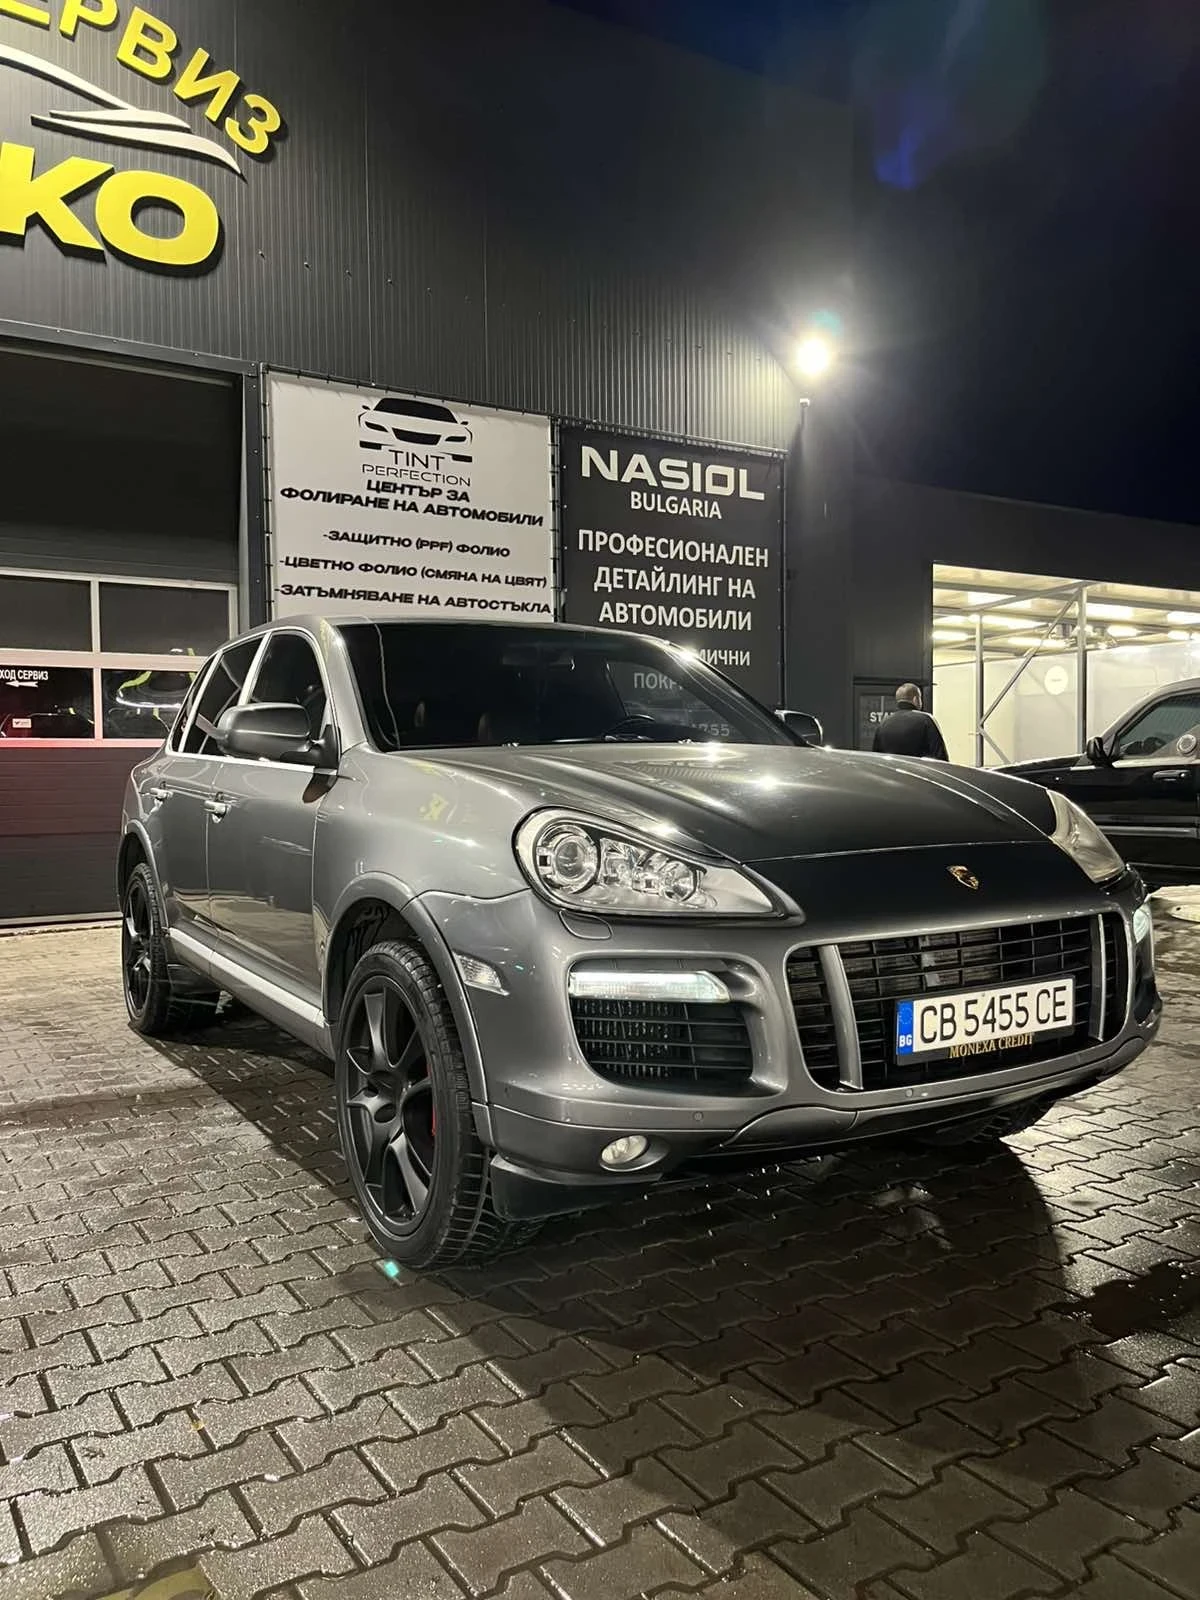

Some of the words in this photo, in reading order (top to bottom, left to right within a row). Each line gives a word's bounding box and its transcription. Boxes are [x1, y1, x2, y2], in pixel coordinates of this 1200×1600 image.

[388, 449, 445, 470] TINT
[581, 445, 765, 501] NASIOL
[362, 463, 471, 487] PERFECTION
[366, 479, 443, 500] ЦЕНТЪР
[446, 489, 471, 503] ЗА
[630, 491, 722, 520] BULGARIA
[280, 487, 390, 510] ФОЛИРАНЕ
[393, 499, 420, 514] НА
[423, 503, 544, 527] АВТОМОБИЛИ
[323, 530, 413, 549] -ЗАЩИТНО
[415, 537, 453, 553] (PPF)
[456, 543, 511, 558] ФОЛИО
[578, 528, 769, 568] ПРОФЕСИОНАЛЕН
[279, 555, 355, 572] -ЦВЕТНО
[358, 562, 418, 577] ФОЛИО
[421, 566, 478, 583] (СМЯНА
[481, 573, 502, 585] НА
[504, 575, 548, 589] ЦВЯТ)
[594, 565, 722, 597] ДЕТАЙЛИНГ
[728, 577, 756, 600] НА
[274, 584, 415, 605] -ЗАТЪМНЯВАНЕ
[417, 594, 441, 607] НА
[444, 597, 552, 614] АВТОСТЪКЛА
[598, 601, 752, 631] АВТОМОБИЛИ
[17, 669, 49, 681] СЕРВИЗ
[920, 1003, 957, 1044] CB
[964, 992, 1029, 1037] 5455
[1036, 986, 1067, 1024] CE
[900, 1034, 913, 1046] BG
[949, 1039, 996, 1058] MONEXA
[998, 1033, 1033, 1050] CREDIT
